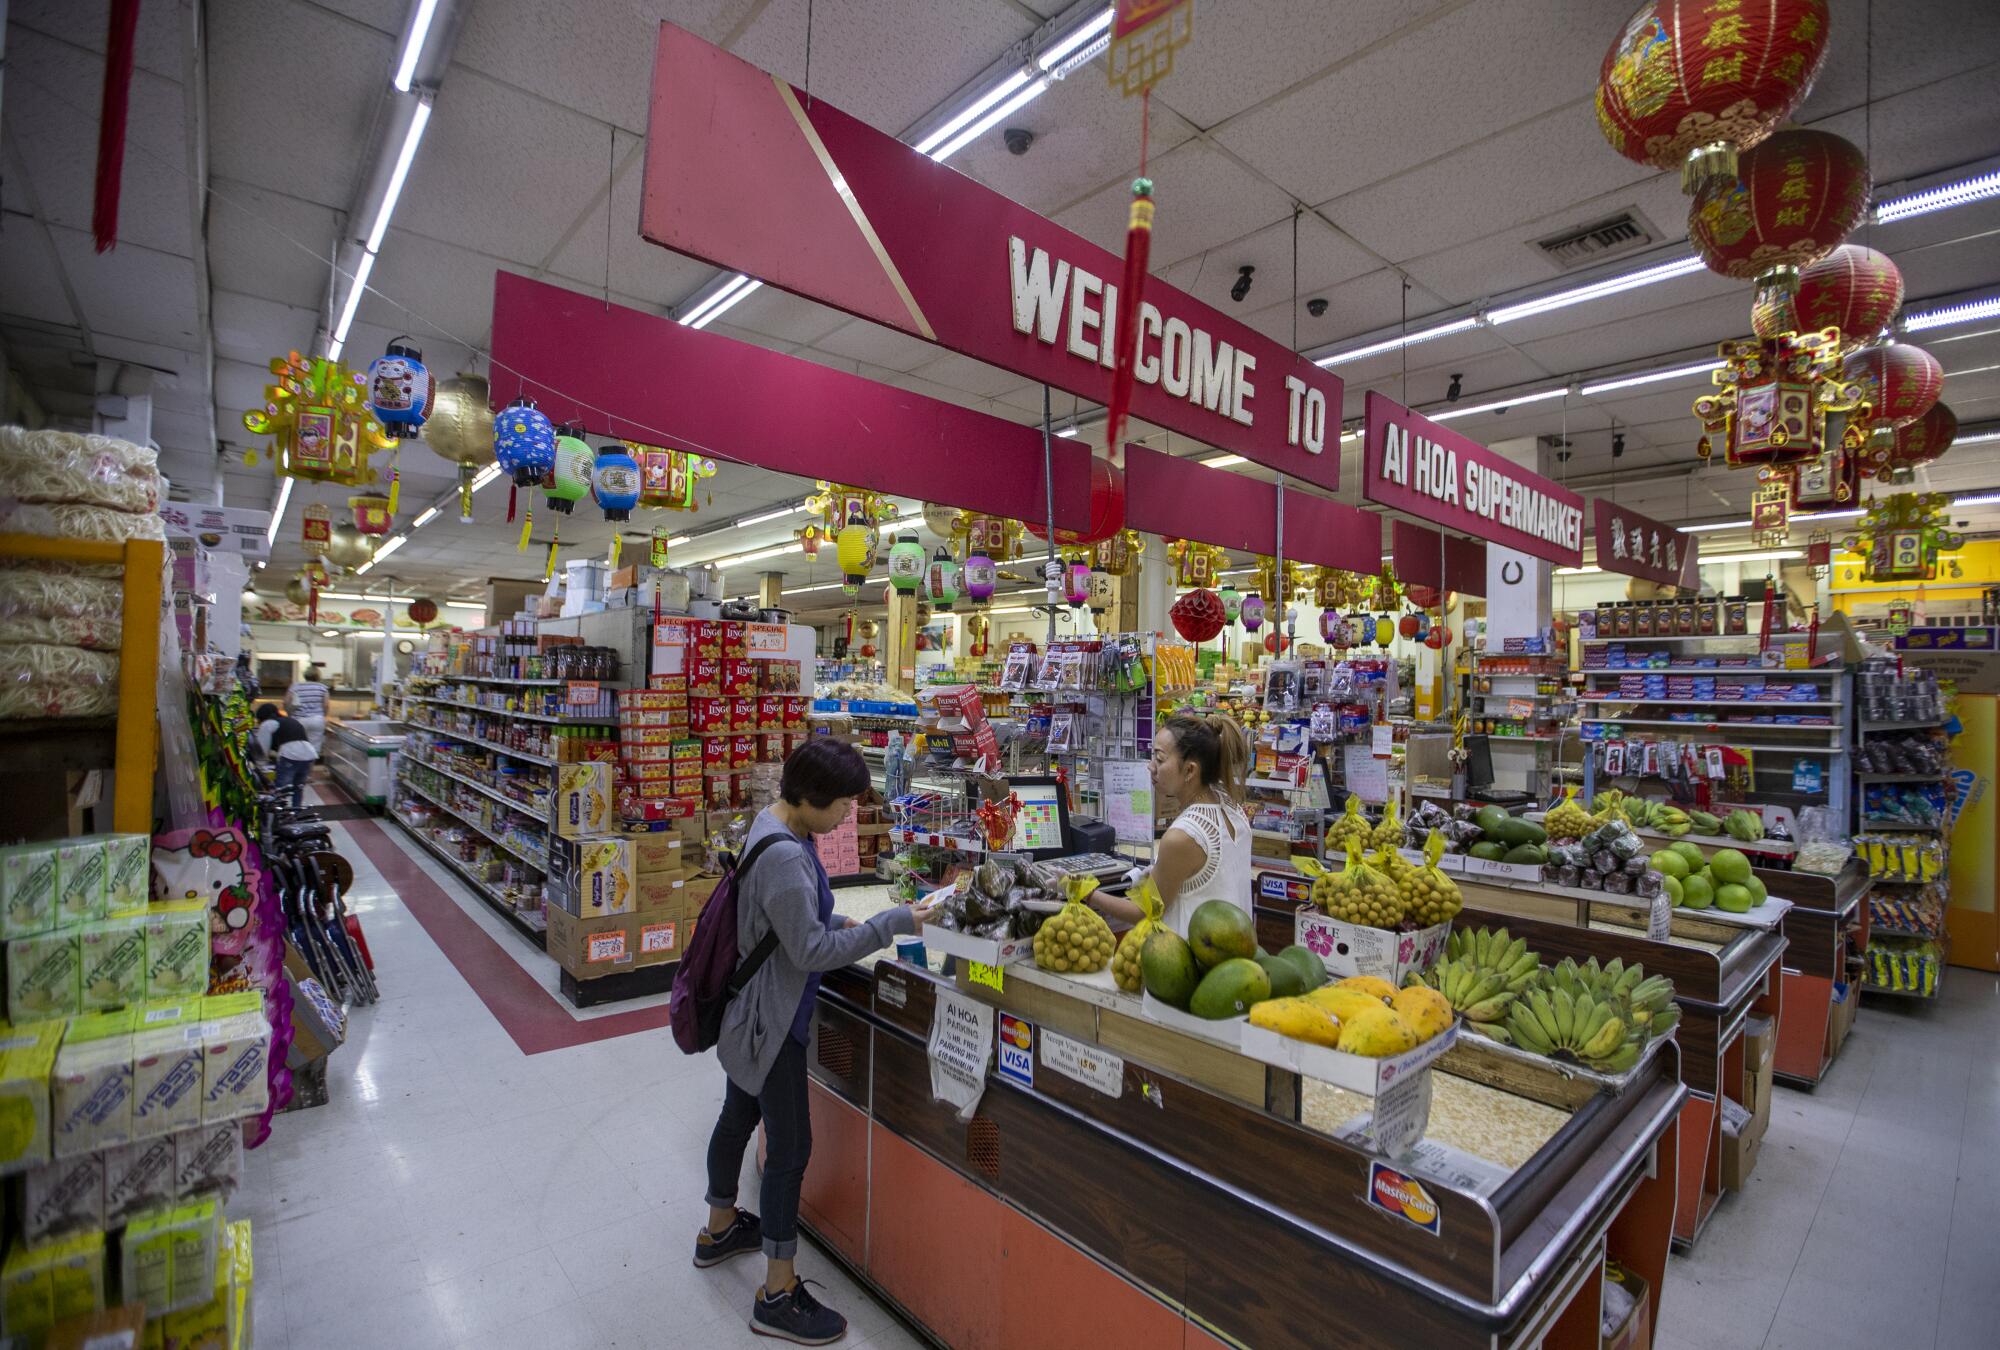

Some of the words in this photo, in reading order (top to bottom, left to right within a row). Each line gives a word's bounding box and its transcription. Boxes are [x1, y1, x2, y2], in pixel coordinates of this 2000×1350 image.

[1009, 234, 1256, 426] WELCOME
[1286, 375, 1326, 454] TO
[1383, 422, 1408, 486] AI
[1415, 436, 1459, 506] HOA
[1464, 459, 1583, 552] SUPERMARKET
[752, 625, 783, 633] SPECIAL
[931, 739, 949, 748] Advil
[1264, 880, 1284, 890] VISA
[947, 1003, 956, 1016] AI
[958, 1008, 979, 1026] HOA
[946, 1018, 979, 1039] PARKING
[939, 1040, 965, 1056] PARKING
[965, 1051, 980, 1064] WITH
[963, 1037, 978, 1052] FREE
[948, 1056, 974, 1072] MINIMUM
[1004, 1048, 1030, 1072] VISA
[1376, 1179, 1433, 1216] MasterCard
